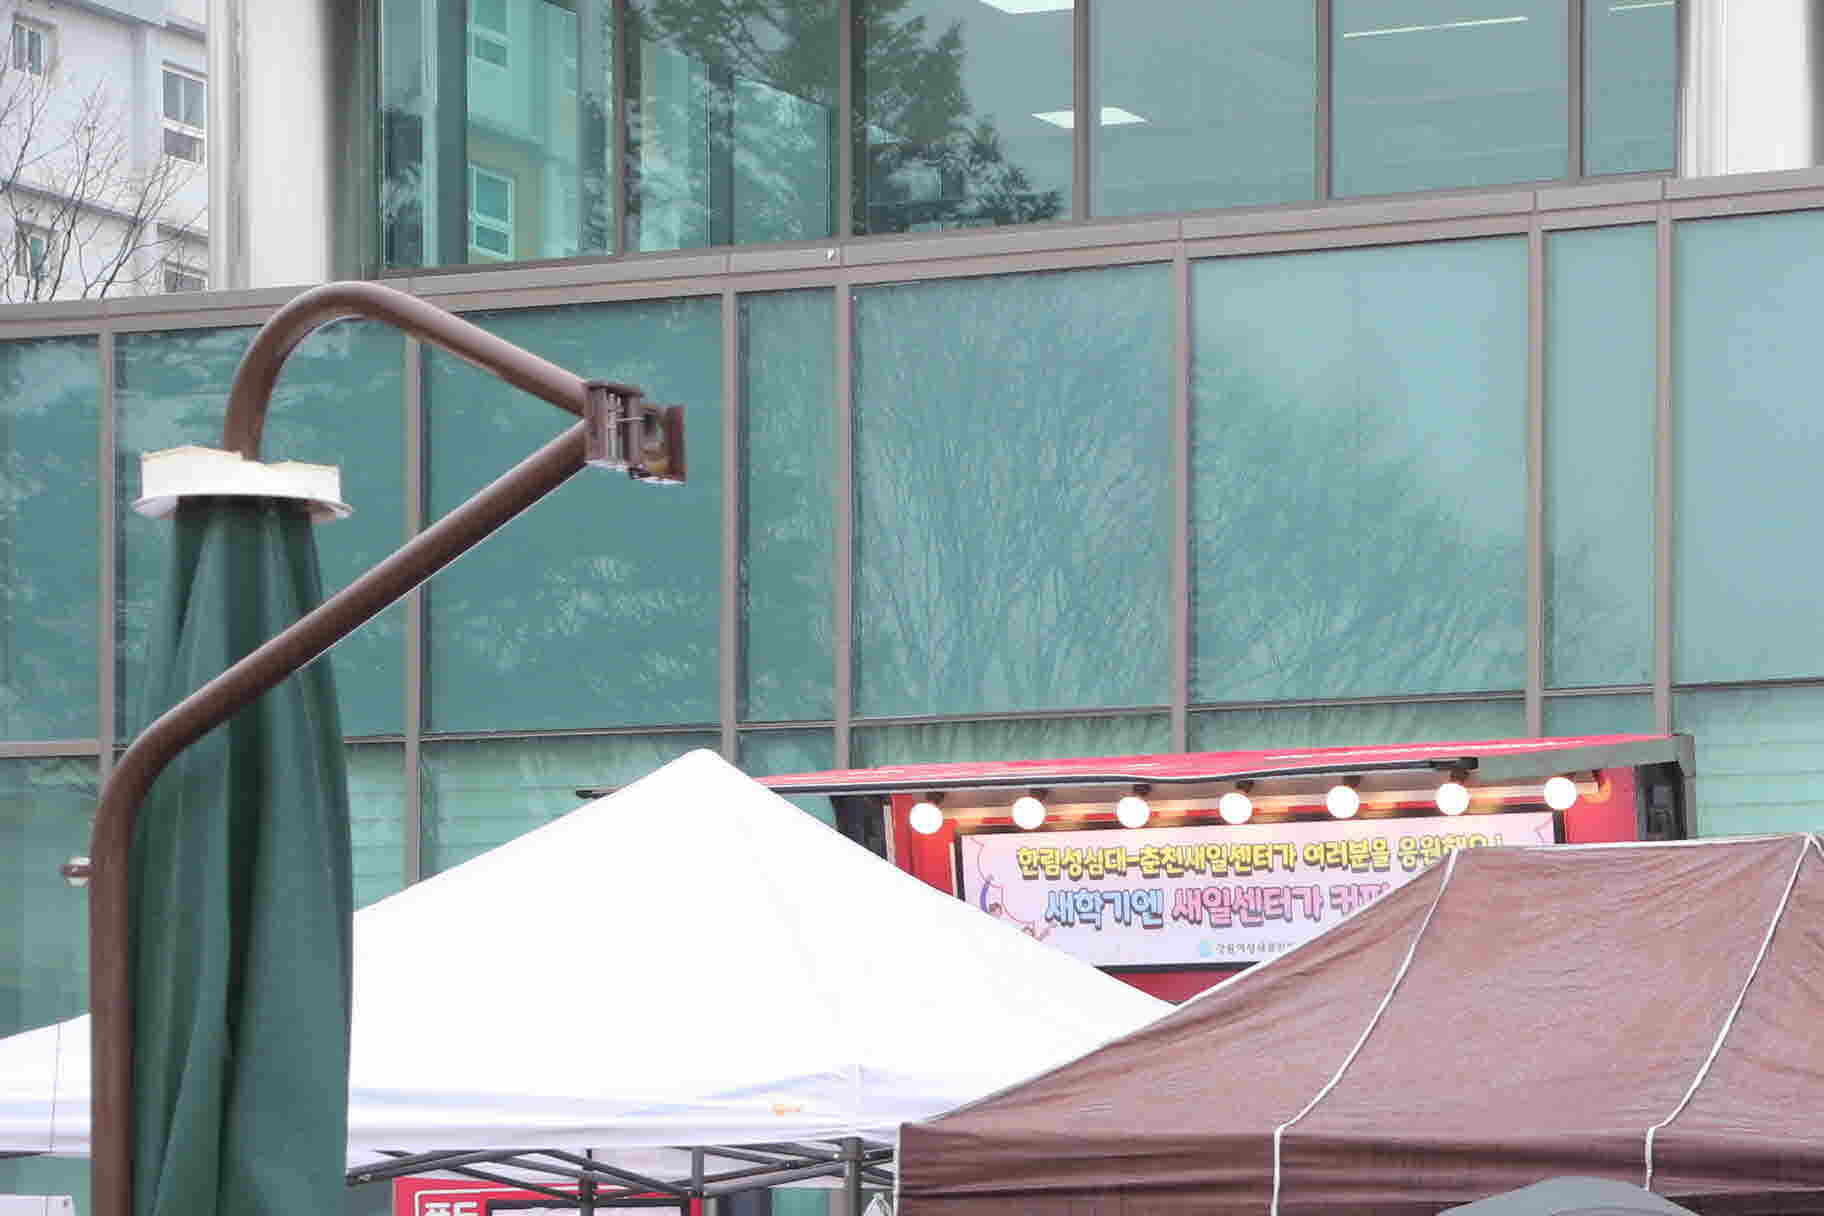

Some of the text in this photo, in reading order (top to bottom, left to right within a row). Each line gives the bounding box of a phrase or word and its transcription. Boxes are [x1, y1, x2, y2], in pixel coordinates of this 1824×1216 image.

[1303, 836, 1391, 872] 여러분을
[1046, 887, 1164, 930] 새학기엔
[1171, 884, 1323, 929] 새일센터가
